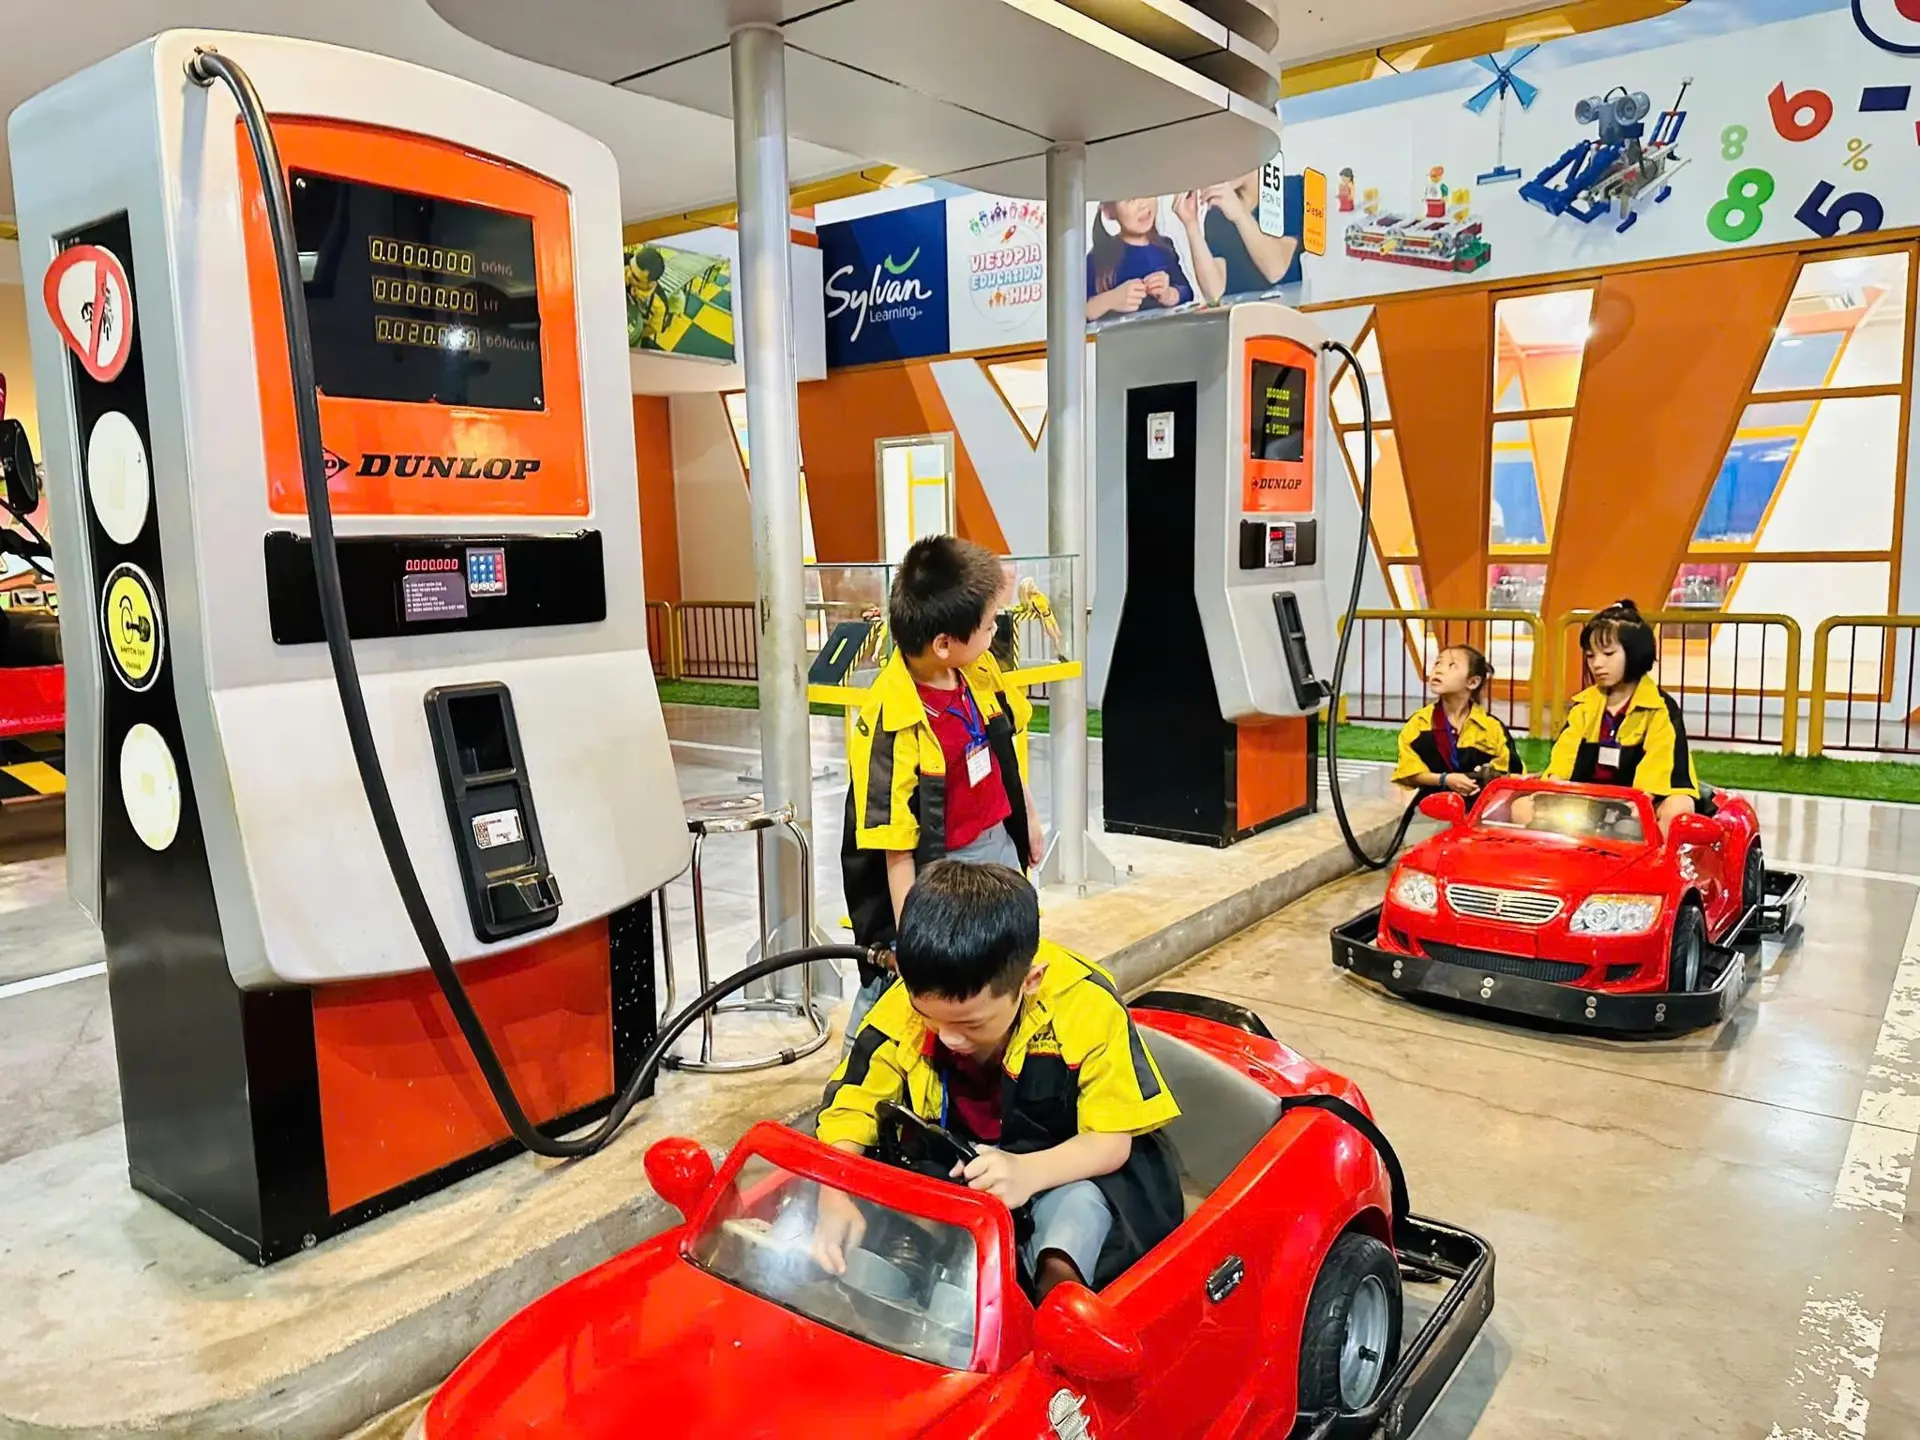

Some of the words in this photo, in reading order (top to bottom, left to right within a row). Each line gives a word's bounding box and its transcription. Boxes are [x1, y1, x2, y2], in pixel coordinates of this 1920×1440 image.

[1767, 80, 1834, 142] 6
[1721, 125, 1748, 161] 8
[1843, 138, 1873, 171] %
[1263, 162, 1281, 192] E5
[1706, 168, 1775, 243] 8
[1794, 180, 1884, 238] 5
[970, 265, 1043, 291] EDUCATION
[825, 264, 933, 342] Sylvan
[1008, 284, 1042, 305] HUB
[869, 305, 917, 323] Learning
[355, 453, 541, 480] DUNLOP
[1260, 479, 1302, 490] DUNLOP
